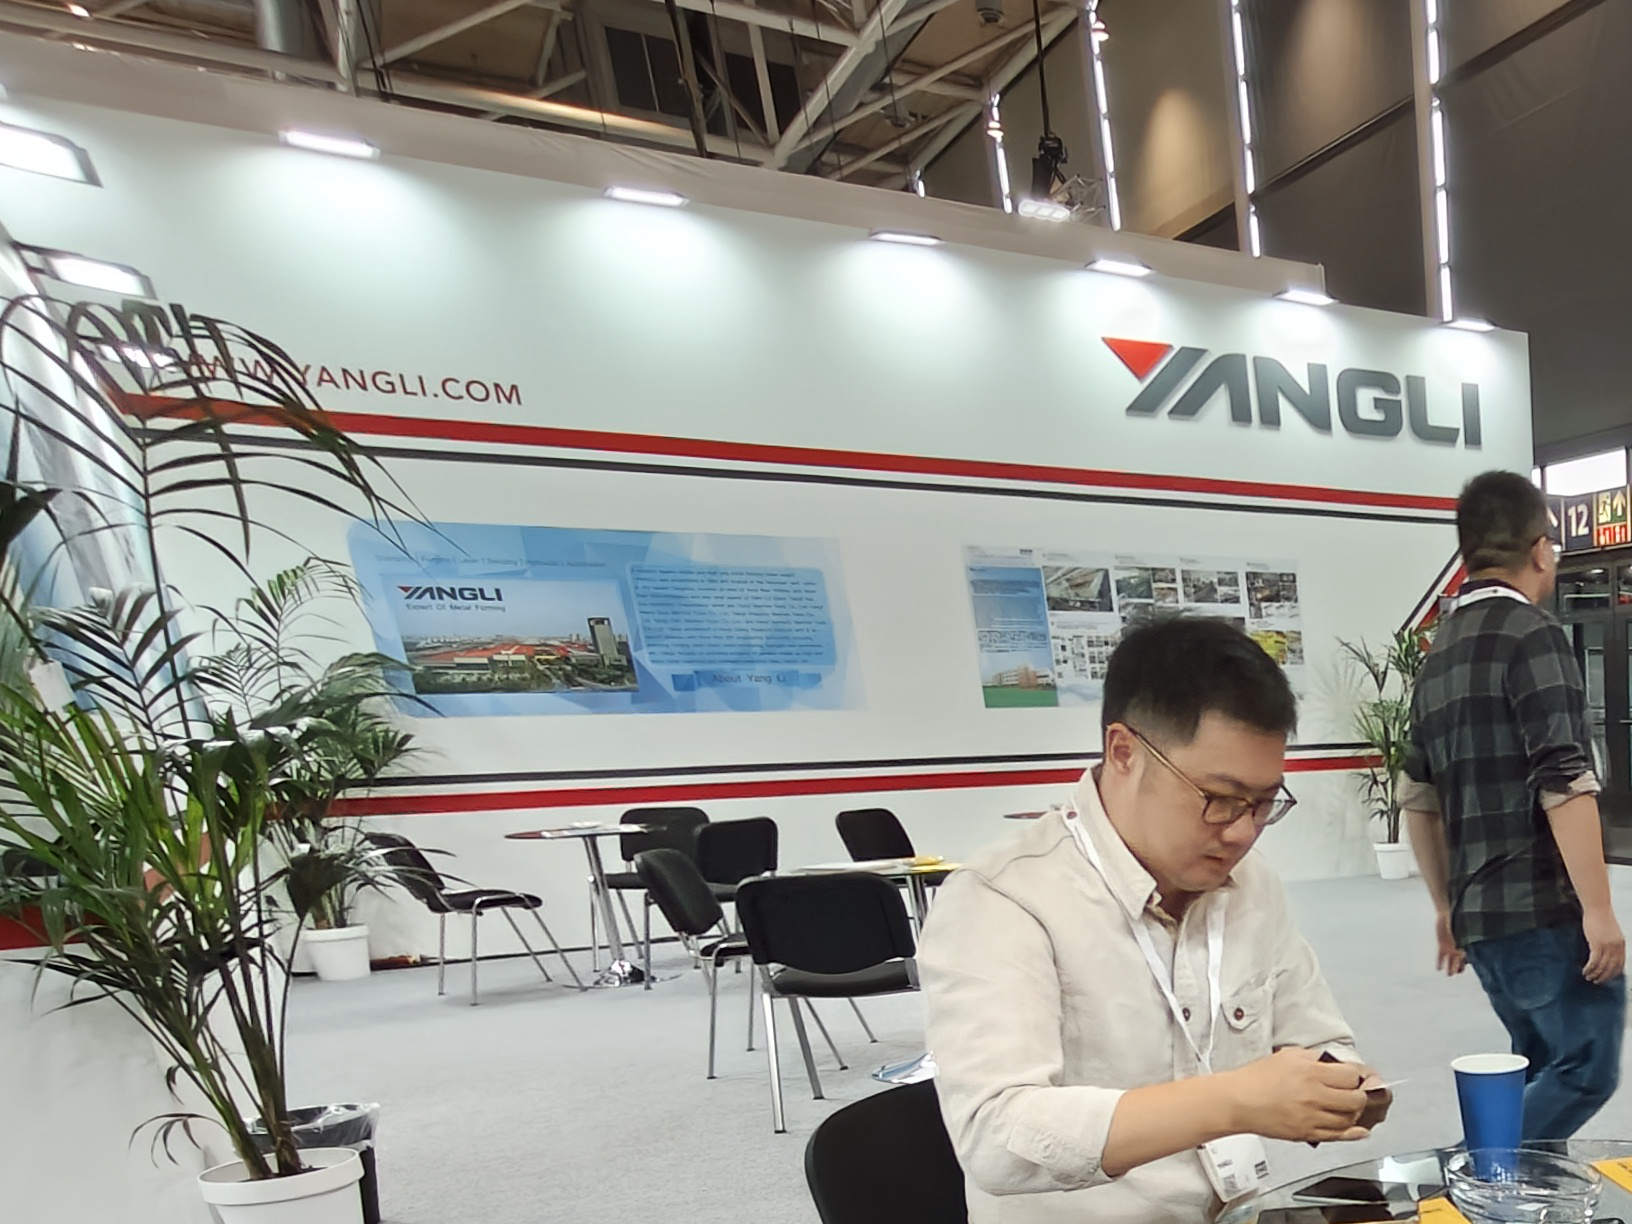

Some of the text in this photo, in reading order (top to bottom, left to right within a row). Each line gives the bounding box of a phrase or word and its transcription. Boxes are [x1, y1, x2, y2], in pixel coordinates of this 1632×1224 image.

[1101, 336, 1483, 450] YANGLI
[1567, 503, 1590, 538] 12
[397, 585, 504, 602] YANGLI
